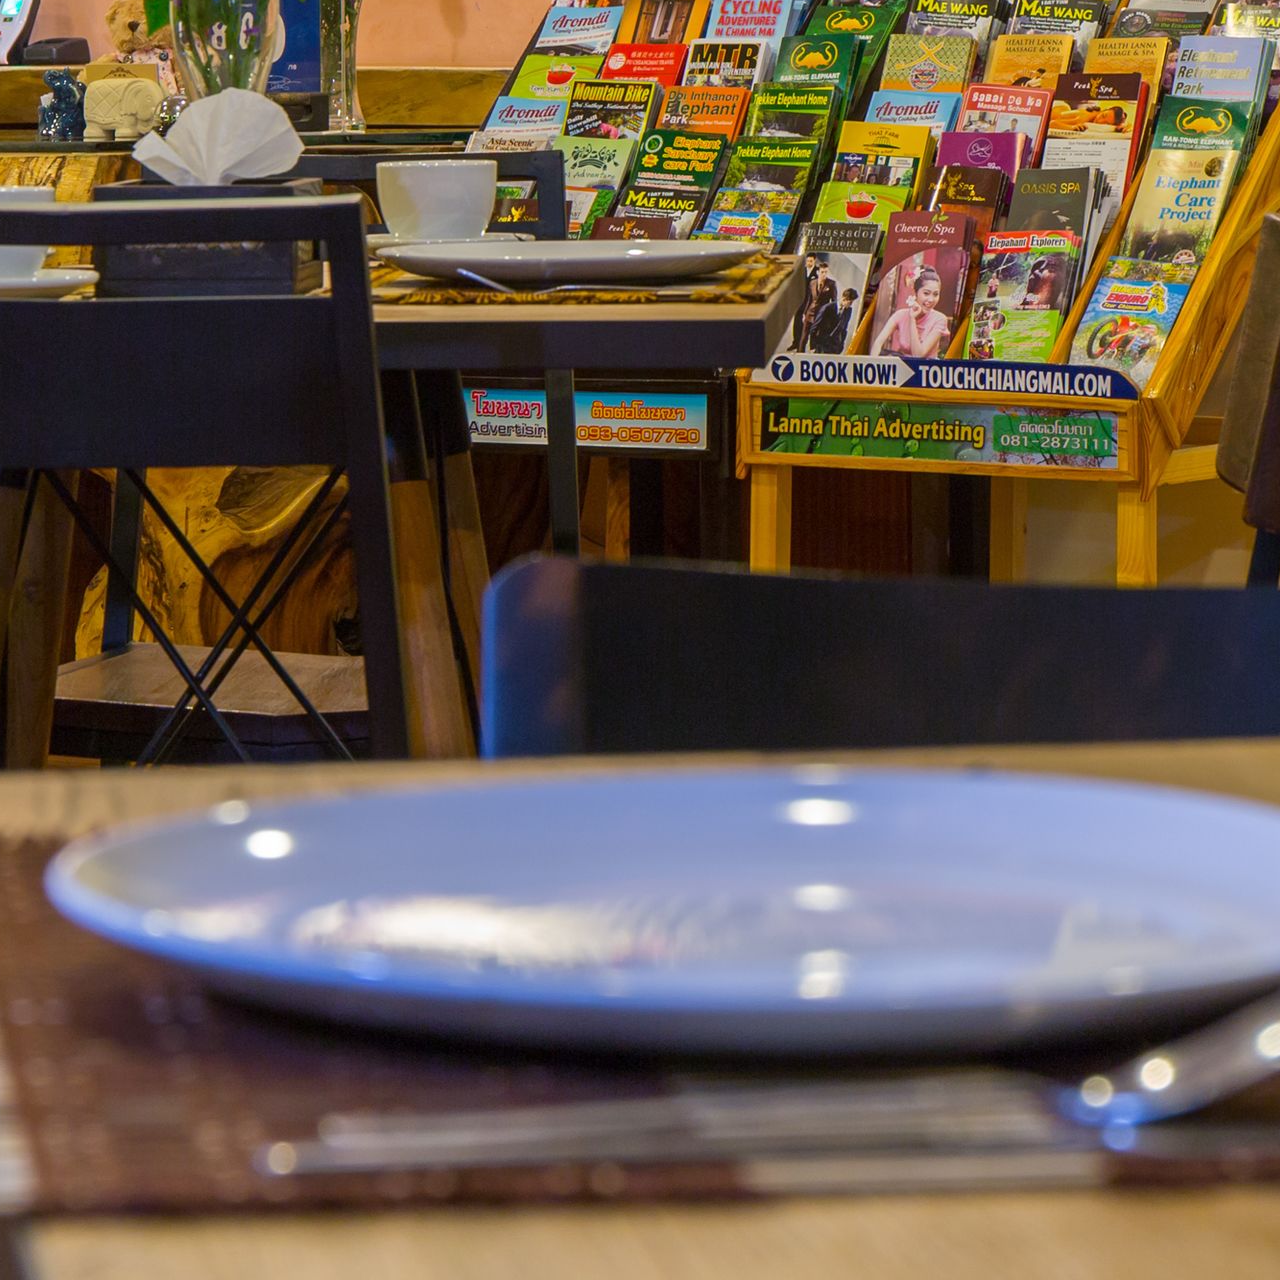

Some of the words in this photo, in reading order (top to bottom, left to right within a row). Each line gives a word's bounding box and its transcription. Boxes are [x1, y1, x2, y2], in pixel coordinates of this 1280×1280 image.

[721, 0, 782, 15] CYCLING
[950, 3, 988, 15] WANG
[1021, 0, 1052, 16] MAE
[1053, 7, 1093, 20] WANG
[552, 11, 611, 30] Aromdii
[718, 15, 776, 26] ADVENTURES
[1006, 38, 1036, 46] HEALTH
[1127, 42, 1157, 50] LANNA
[572, 83, 625, 101] Mountain
[624, 86, 650, 102] Bike
[669, 91, 686, 100] Doi
[691, 92, 739, 101] Inthanon
[1174, 82, 1204, 95] Park
[777, 93, 805, 107] Elephant
[806, 94, 828, 105] Home
[498, 105, 560, 120] Aromdii
[665, 101, 737, 117] Elephant
[876, 100, 940, 118] Aromdii
[1008, 105, 1031, 113] School
[662, 114, 688, 124] Park
[488, 137, 506, 145] Asia
[508, 138, 534, 147] Scenic
[673, 136, 722, 150] Elephant
[1163, 136, 1198, 144] RAN-TONG
[662, 147, 718, 162] Sanctuary
[736, 145, 759, 158] Trekker
[761, 145, 792, 160] Elephant
[792, 146, 811, 157] Home
[689, 160, 714, 172] Park
[1021, 183, 1057, 194] OASIS
[1060, 182, 1081, 193] SPA
[1155, 176, 1221, 192] Elephant
[625, 190, 656, 207] MAE
[659, 198, 695, 210] WANG
[1175, 192, 1216, 207] Care
[1159, 207, 1212, 223] Project
[895, 223, 928, 233] Cheeva
[933, 223, 955, 235] Spa
[809, 237, 858, 247] Fashions
[1030, 235, 1066, 248] Explorers
[800, 360, 847, 384] BOOK
[852, 362, 897, 386] NOW!
[919, 365, 1112, 397] TOUCHCHIANGMAI.COM
[472, 390, 543, 419] โฆษณา
[591, 401, 686, 420] ติดต่อโฆษณา
[470, 421, 546, 437] Advertisin
[576, 426, 699, 443] 093-0507720
[768, 412, 823, 434] Lanna
[829, 414, 868, 436] Thai
[873, 416, 986, 449] Advertising
[1001, 434, 1108, 450] 081-2873111
